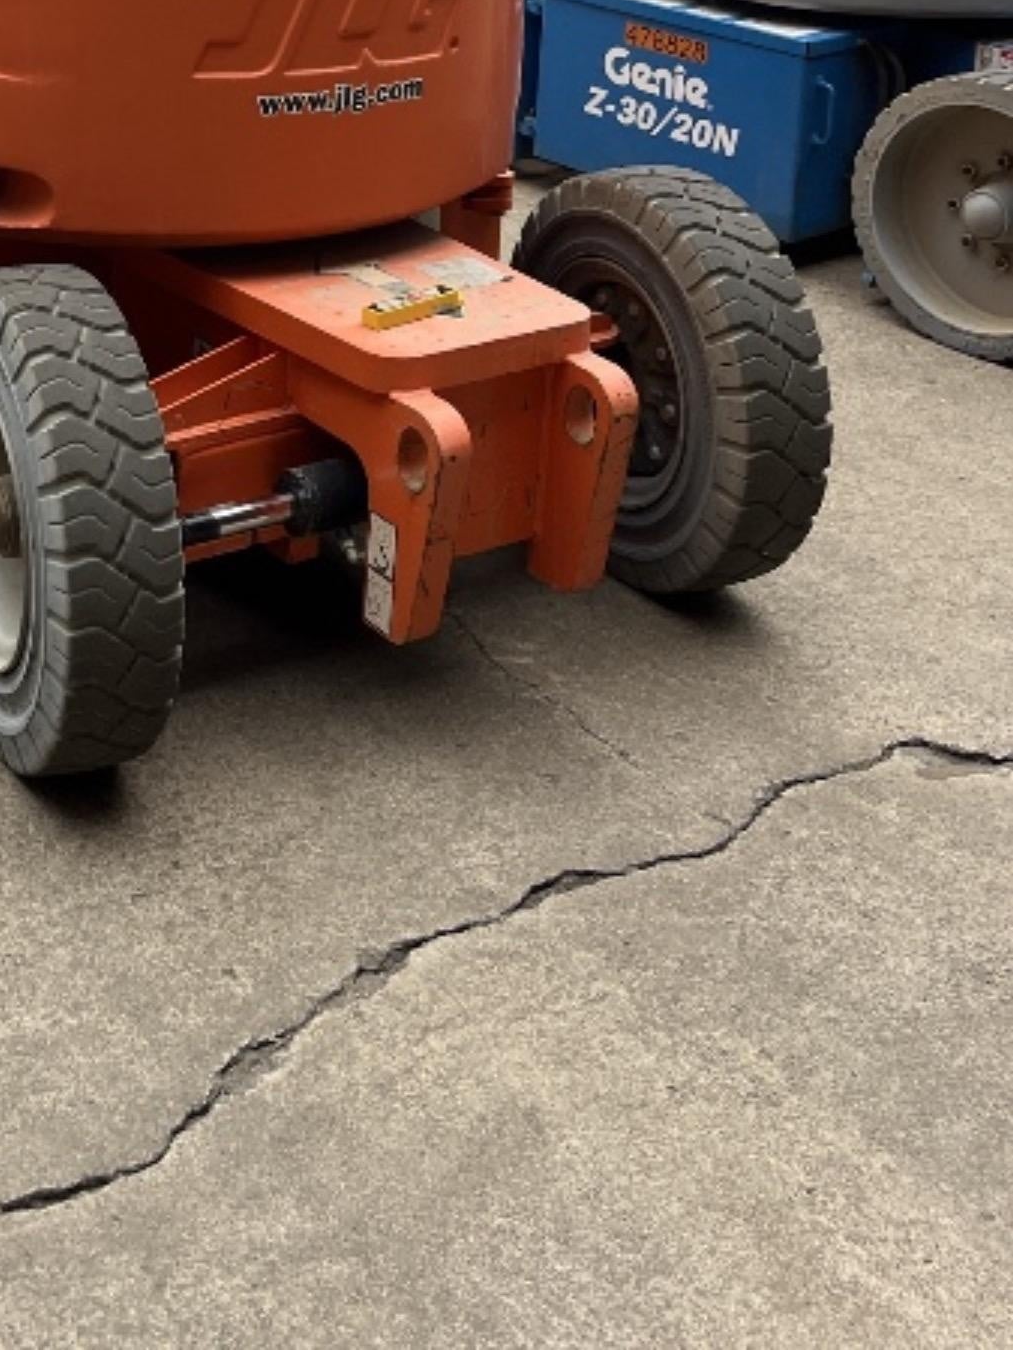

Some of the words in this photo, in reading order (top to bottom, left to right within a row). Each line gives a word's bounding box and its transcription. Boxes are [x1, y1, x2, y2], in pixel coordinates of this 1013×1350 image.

[257, 77, 423, 117] www.jlg.com
[604, 46, 710, 110] Genie
[584, 86, 740, 157] Z-30/20N
